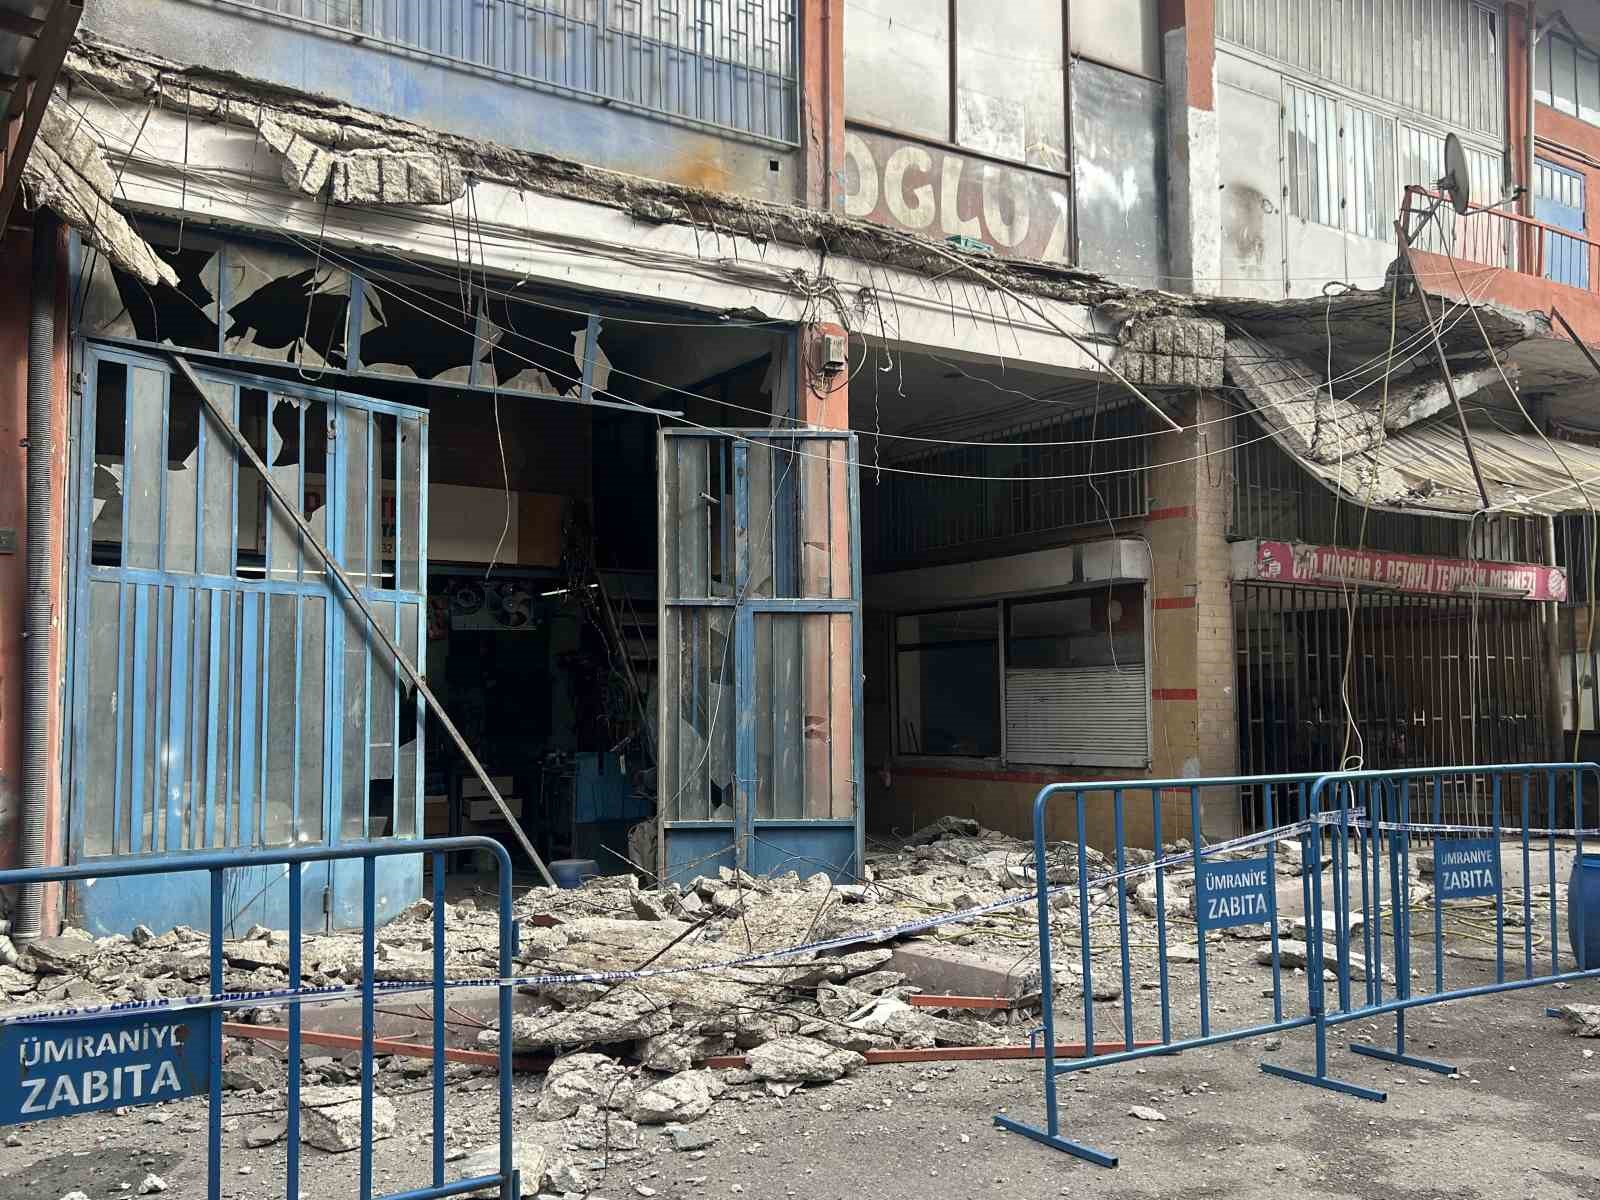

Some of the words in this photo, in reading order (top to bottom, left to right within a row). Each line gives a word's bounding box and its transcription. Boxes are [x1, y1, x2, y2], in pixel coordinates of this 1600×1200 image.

[1206, 869, 1268, 891] ÜMRANİYE
[1442, 868, 1494, 891] ZABITA
[1207, 893, 1268, 920] ZABITA
[20, 1060, 182, 1114] ZABITA
